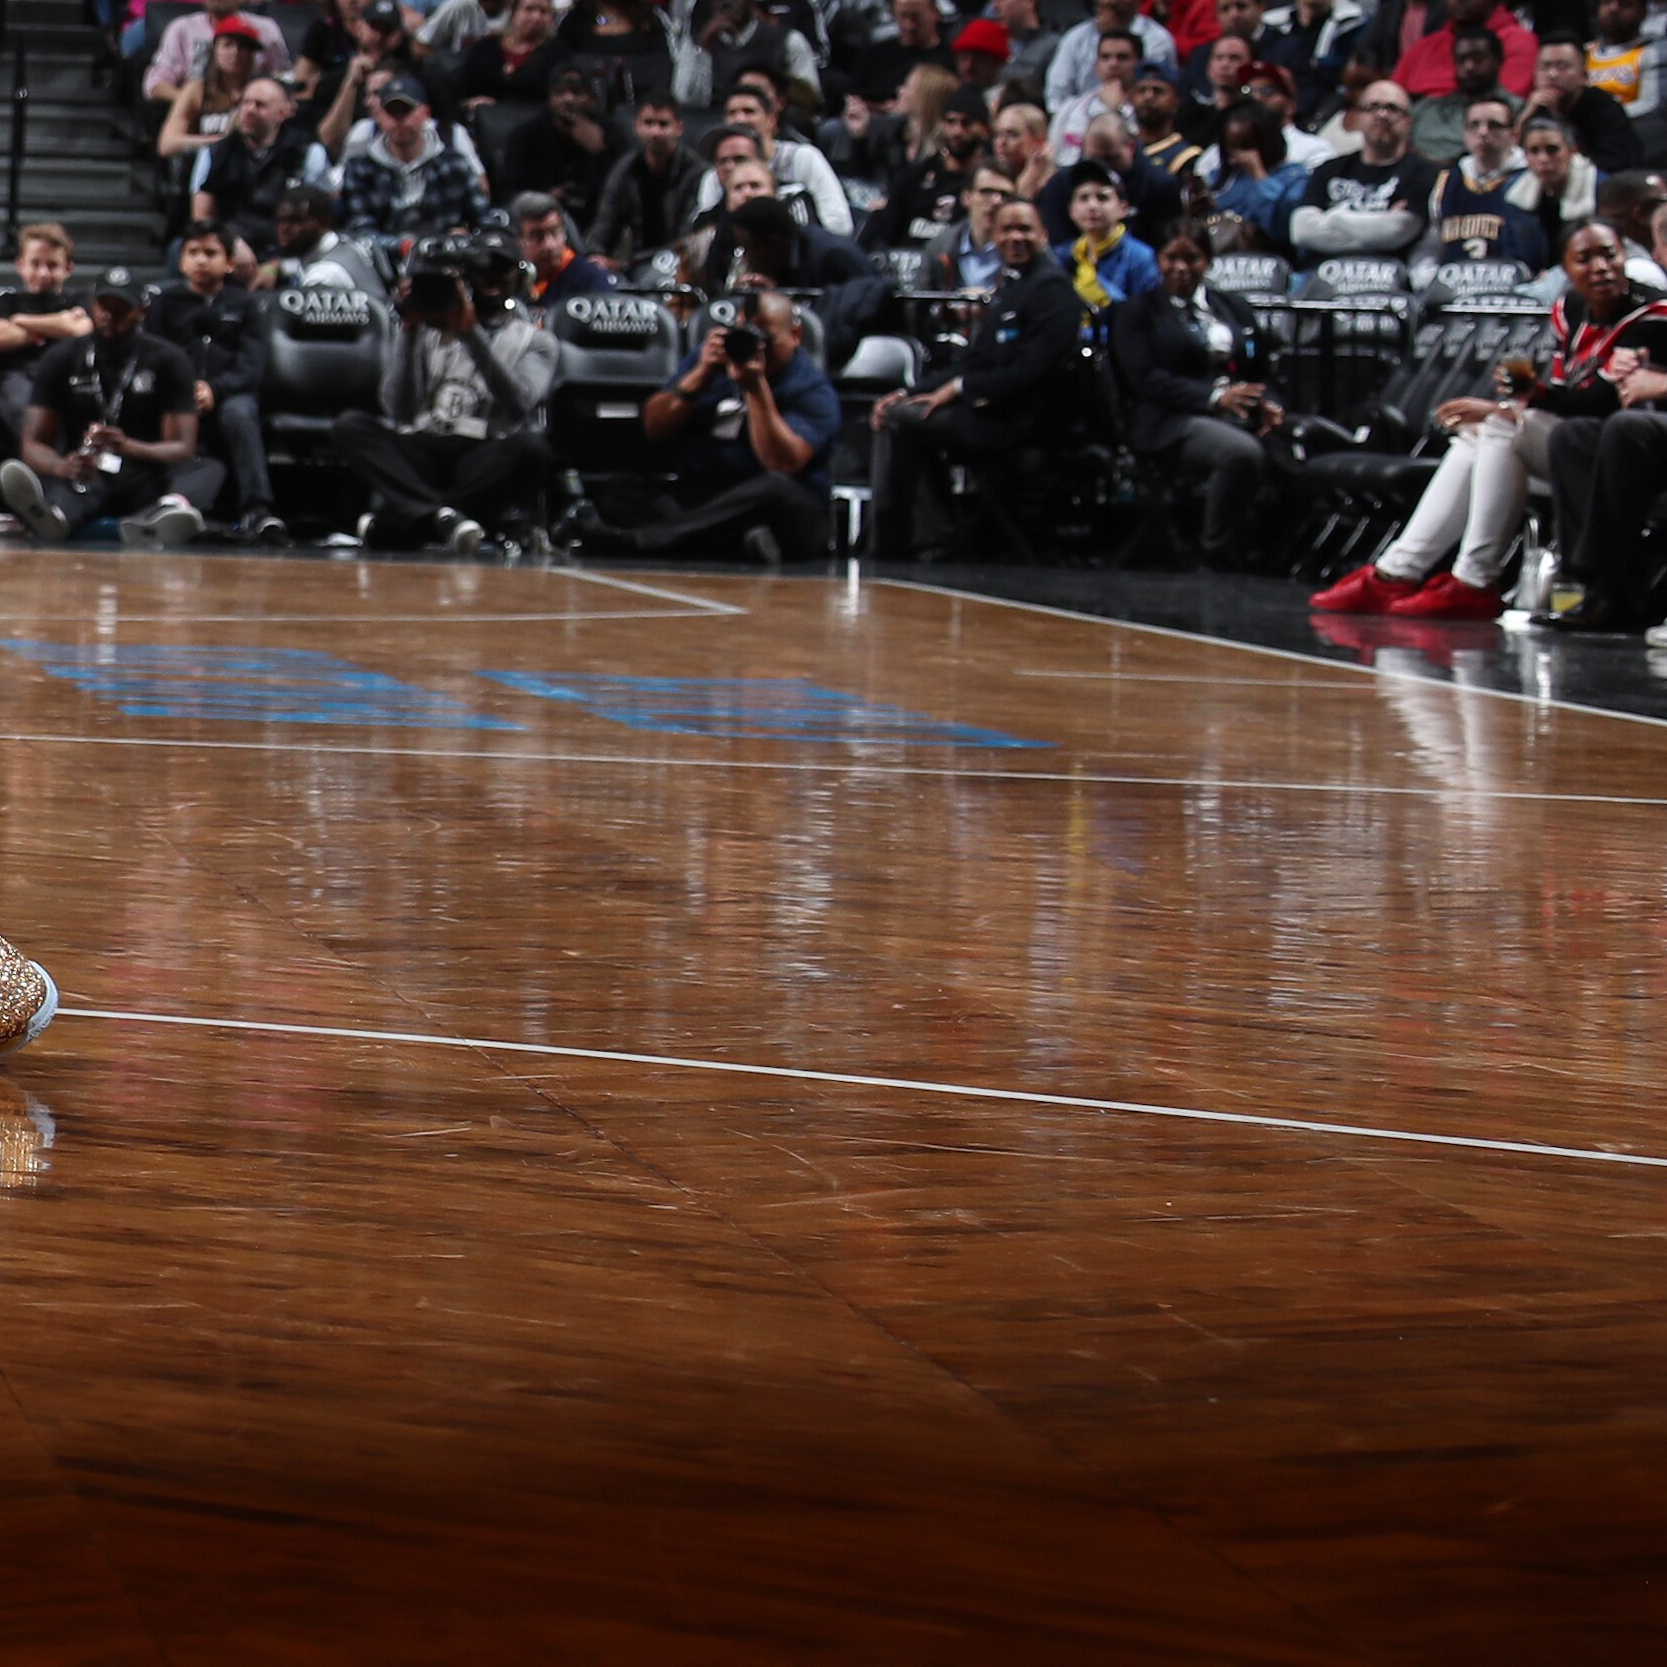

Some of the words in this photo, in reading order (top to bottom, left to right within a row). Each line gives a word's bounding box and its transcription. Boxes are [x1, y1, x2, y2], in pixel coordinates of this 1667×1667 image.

[1438, 261, 1517, 286] QATAR
[278, 288, 370, 315] QATAR
[567, 294, 660, 323] QATAR
